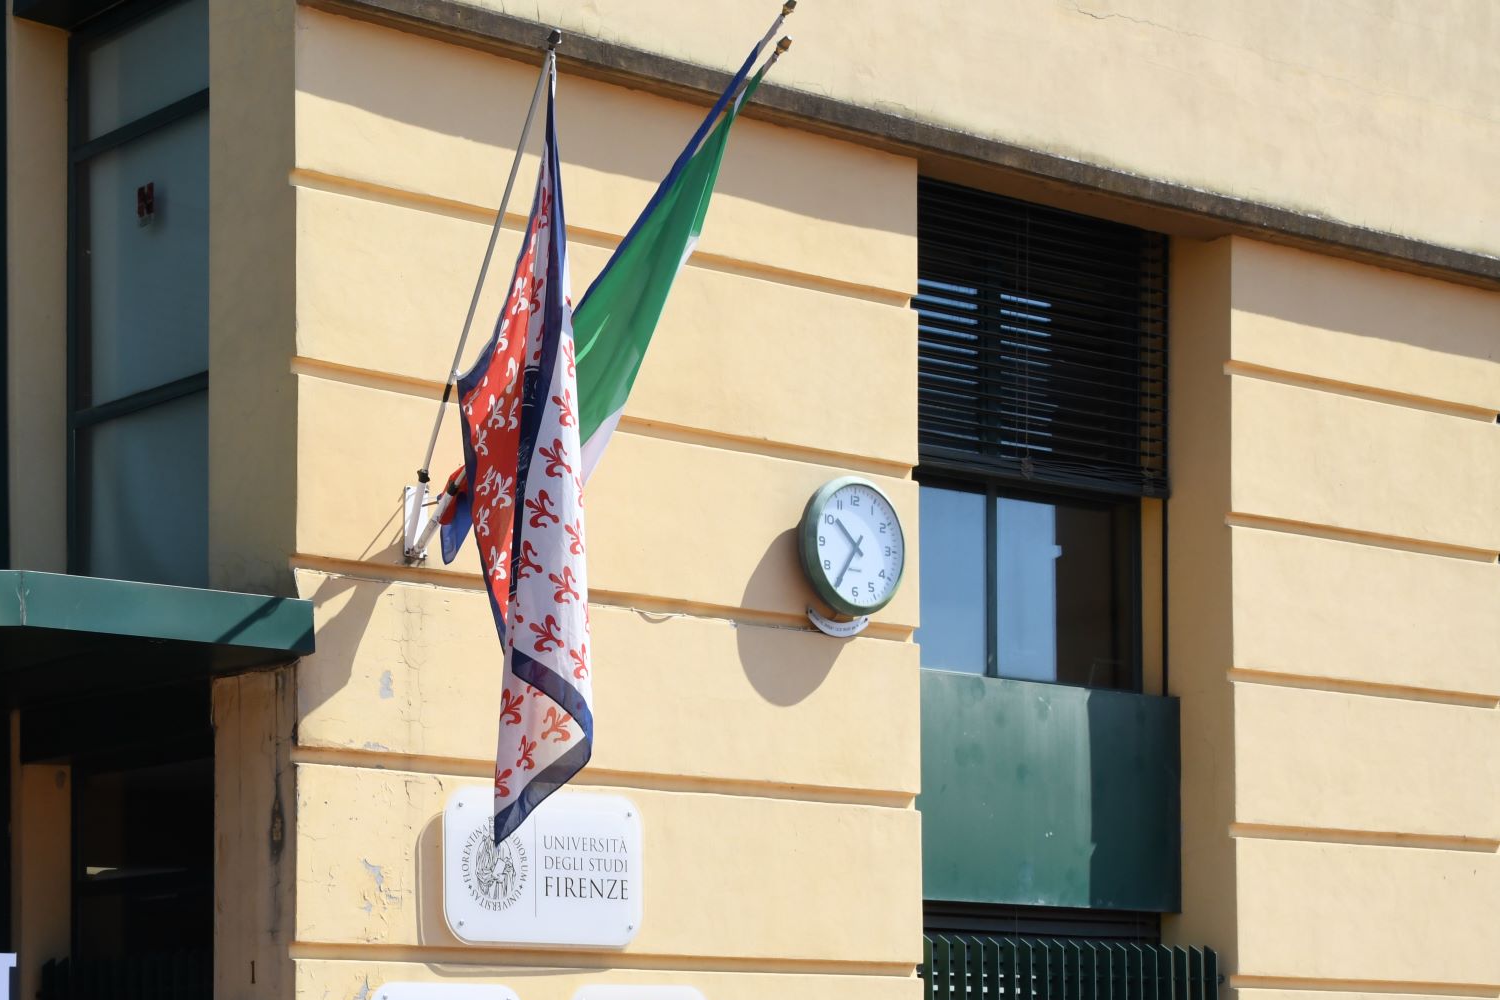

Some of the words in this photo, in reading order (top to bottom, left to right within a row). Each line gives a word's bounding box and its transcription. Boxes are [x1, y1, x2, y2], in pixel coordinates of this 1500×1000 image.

[836, 500, 842, 510] 11
[850, 495, 860, 506] 12
[824, 514, 835, 525] 10
[879, 522, 886, 533] 2
[819, 536, 826, 546] 9
[884, 546, 891, 556] 3
[824, 560, 831, 570] 8
[878, 569, 885, 579] 4
[851, 587, 859, 597] 6
[868, 582, 875, 592] 5
[543, 835, 628, 854] UNIVERSITÀ
[544, 855, 584, 871] DEGLI
[589, 857, 628, 873] STUDI
[544, 876, 629, 900] FIRENZE
